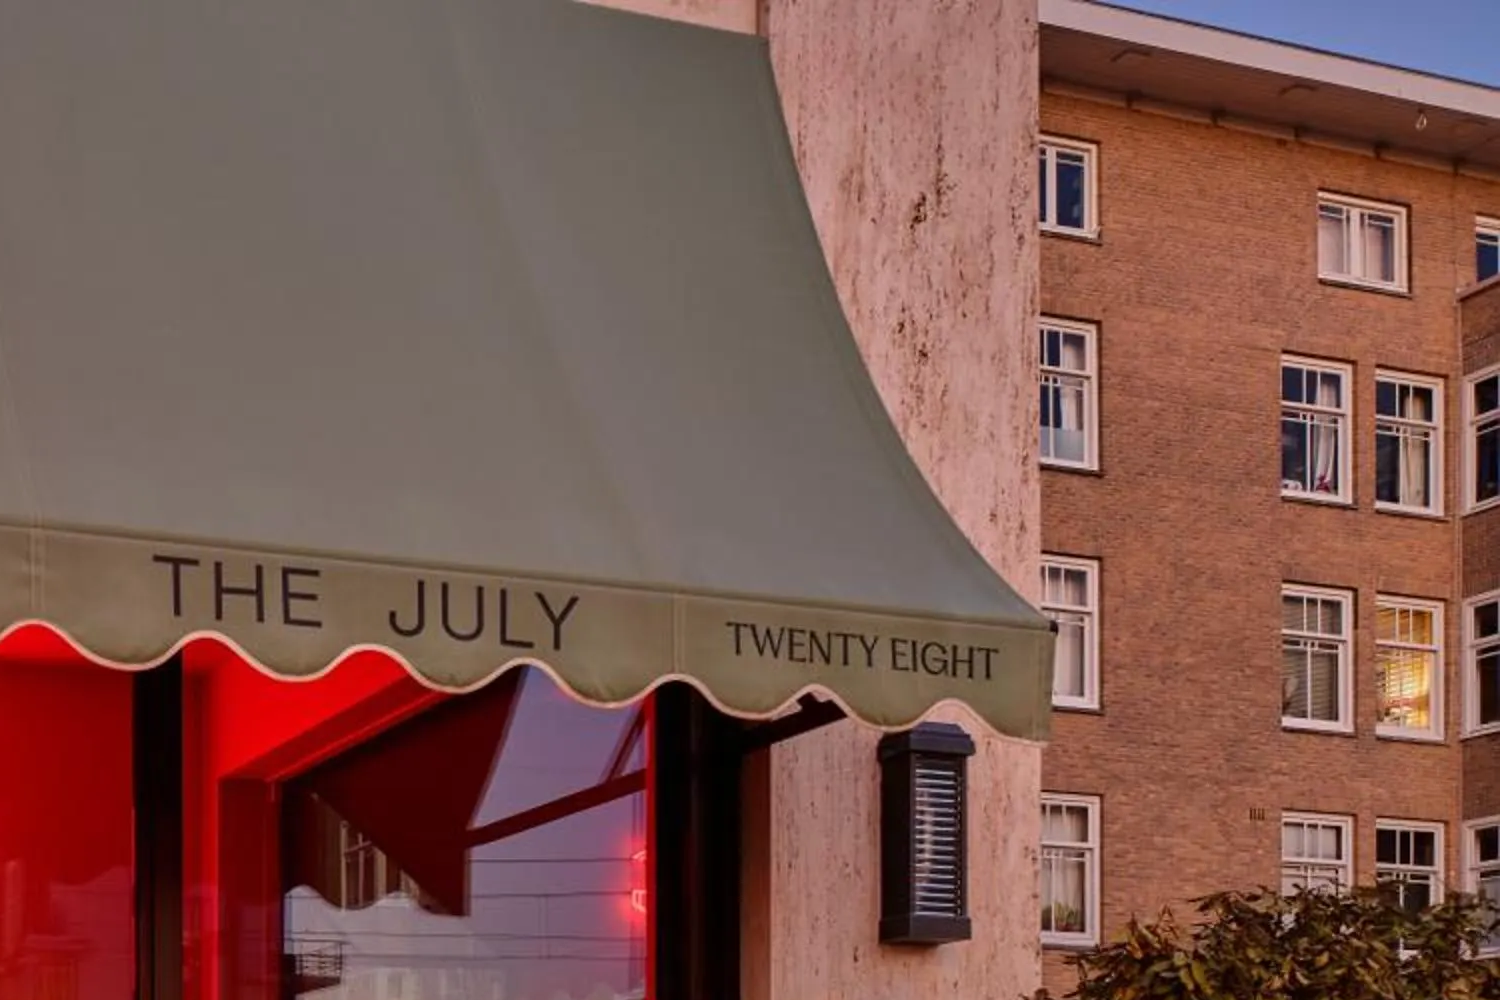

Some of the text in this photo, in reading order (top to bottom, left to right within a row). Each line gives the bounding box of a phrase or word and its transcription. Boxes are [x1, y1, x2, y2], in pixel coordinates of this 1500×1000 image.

[152, 553, 580, 651] THE JULY
[725, 620, 1000, 681] TWENTY EIGHT
